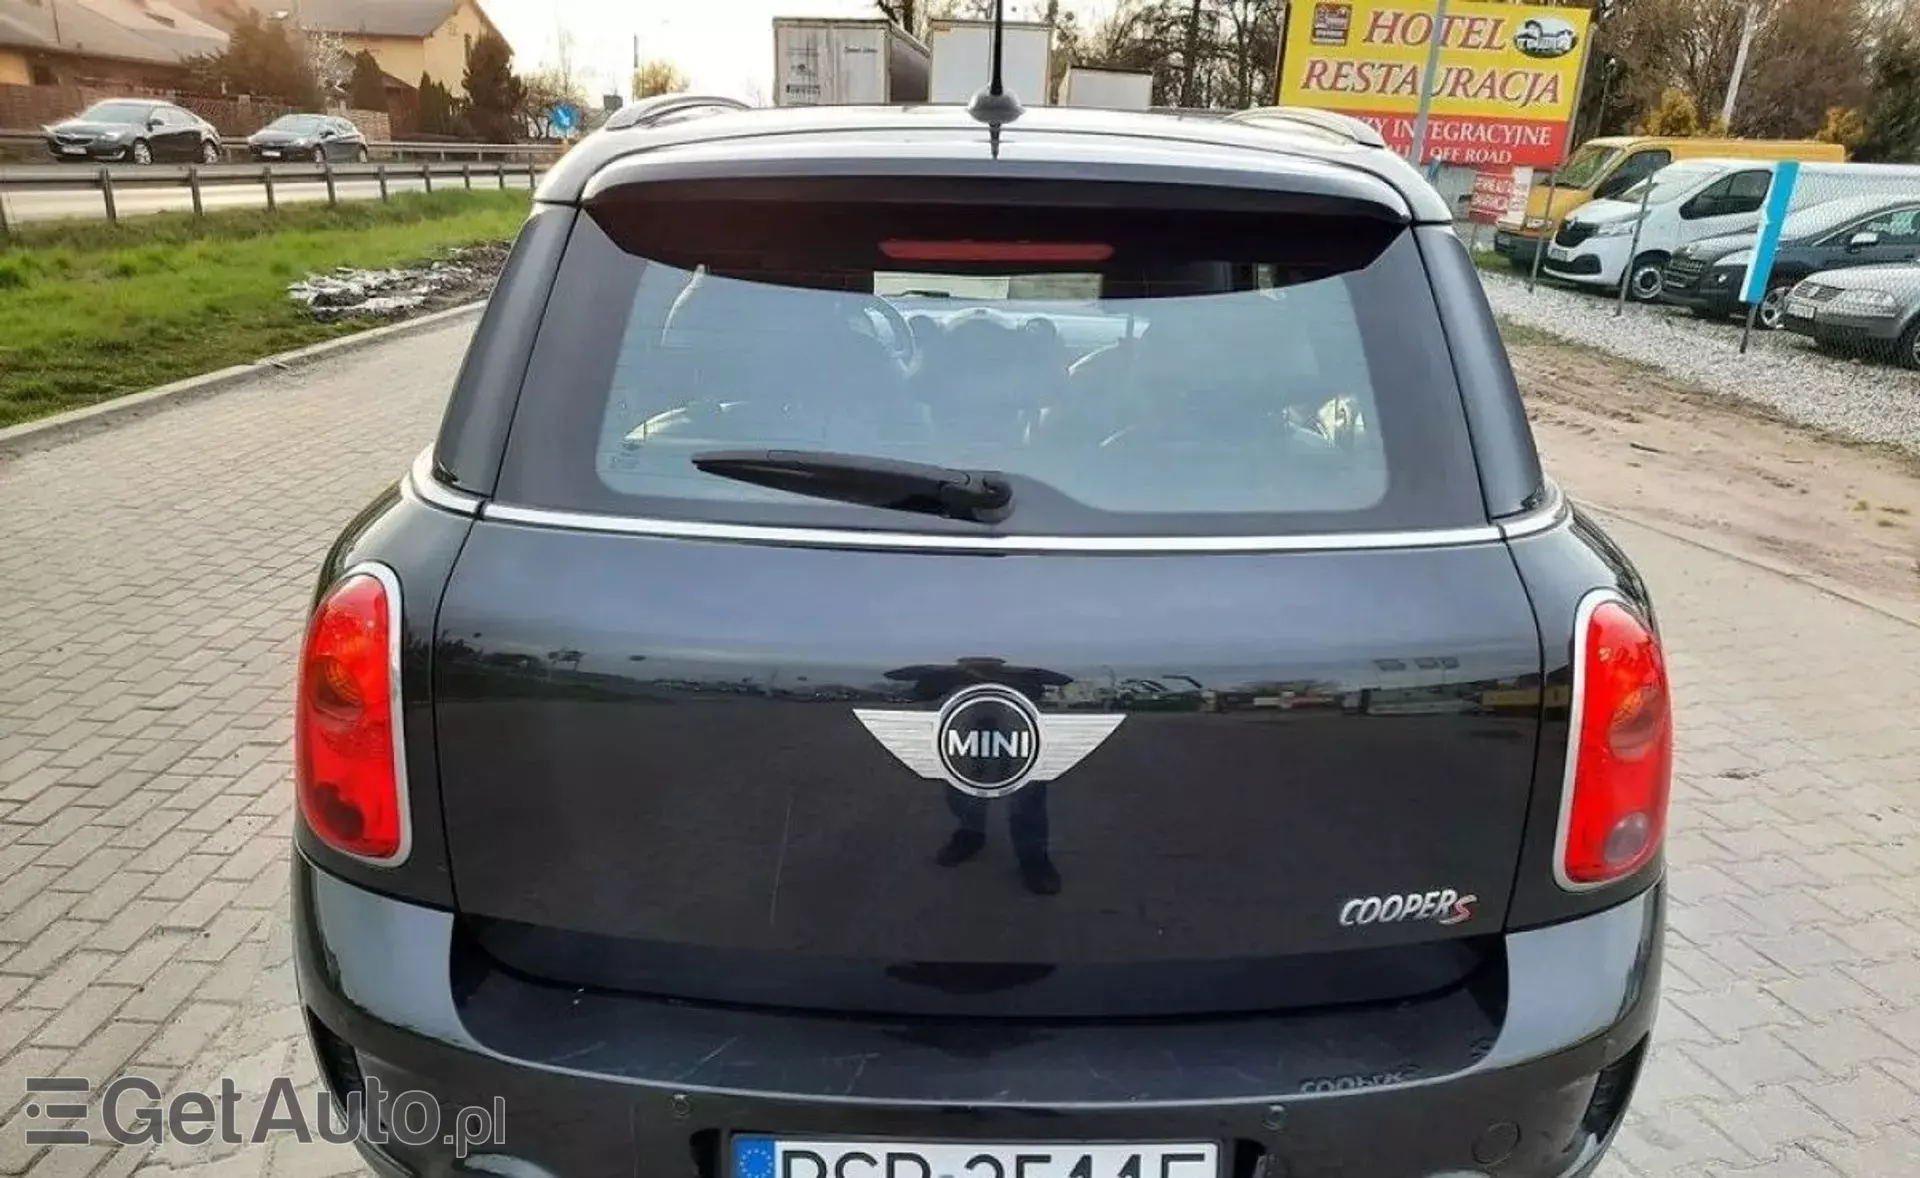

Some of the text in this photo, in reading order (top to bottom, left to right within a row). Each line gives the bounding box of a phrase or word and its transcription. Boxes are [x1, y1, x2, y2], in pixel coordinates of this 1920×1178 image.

[1362, 10, 1508, 51] HOTEL
[1465, 149, 1512, 163] ROAD
[948, 729, 1029, 758] MINI
